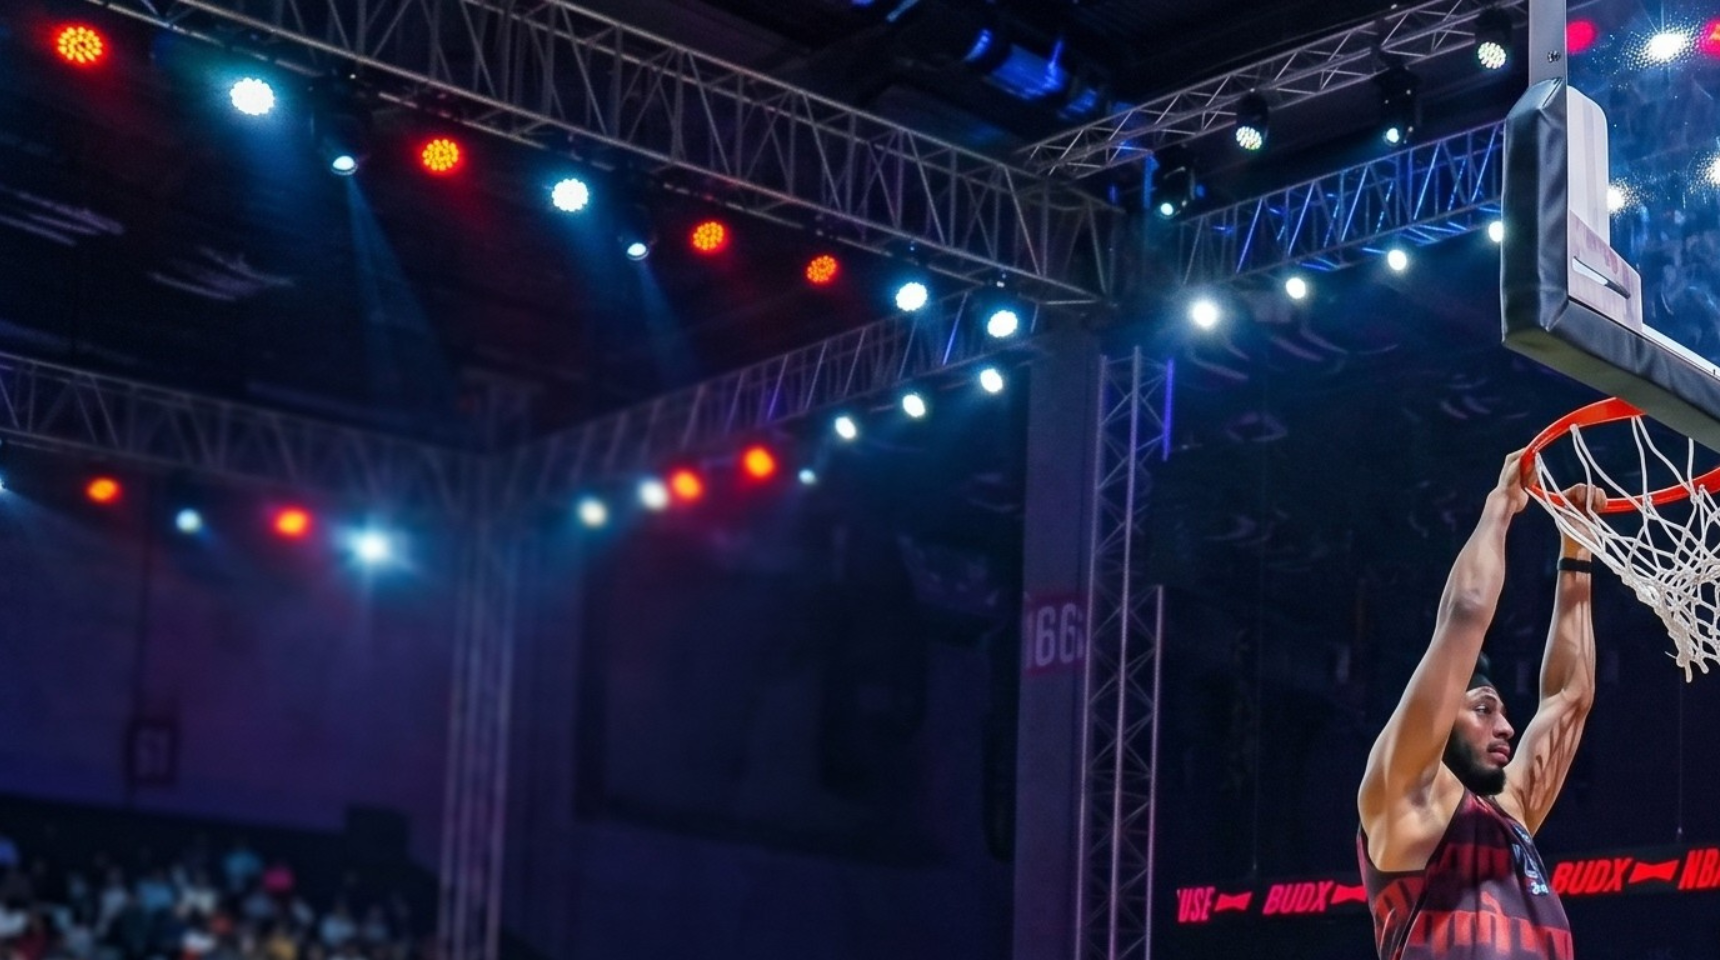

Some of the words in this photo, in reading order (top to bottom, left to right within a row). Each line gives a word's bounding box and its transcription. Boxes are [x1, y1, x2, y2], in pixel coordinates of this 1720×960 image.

[1551, 857, 1634, 894] BUDX
[1177, 886, 1216, 923] USE
[1262, 880, 1335, 915] BUDX
